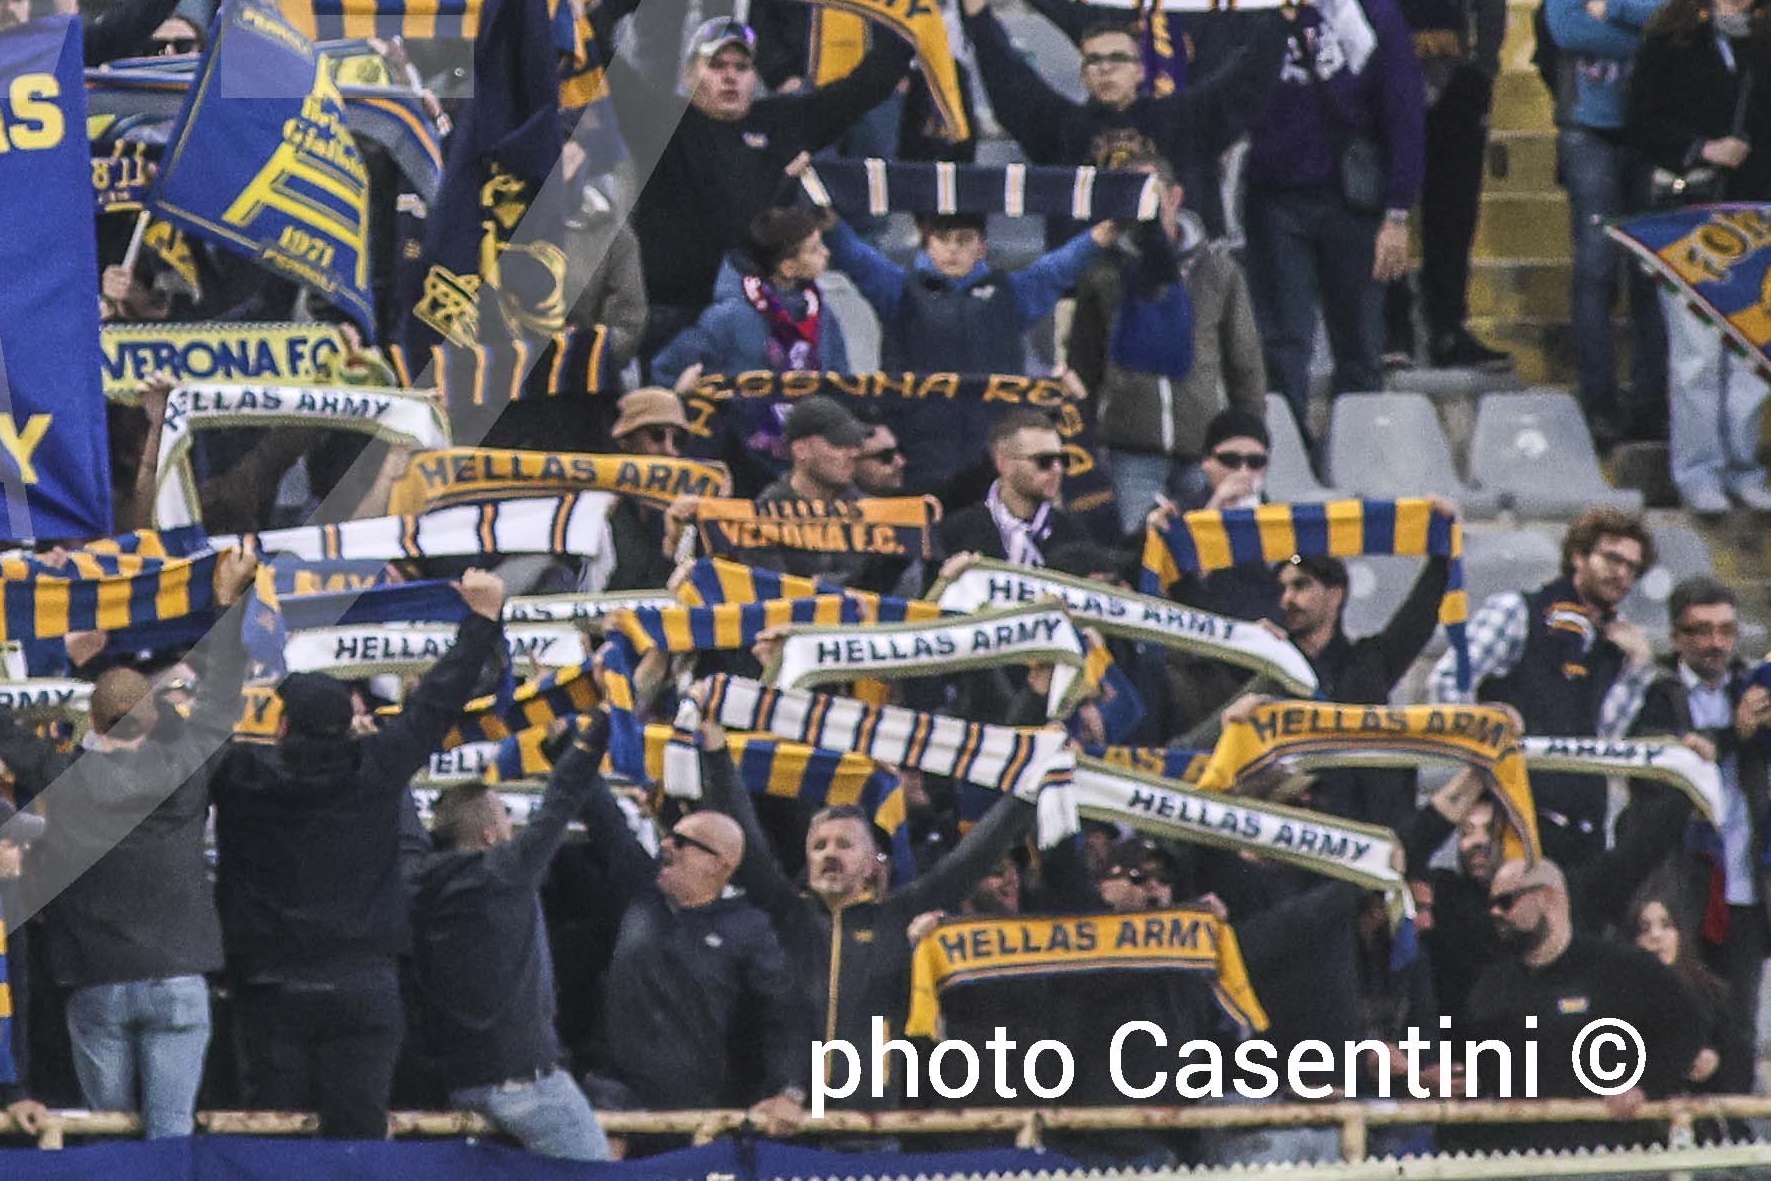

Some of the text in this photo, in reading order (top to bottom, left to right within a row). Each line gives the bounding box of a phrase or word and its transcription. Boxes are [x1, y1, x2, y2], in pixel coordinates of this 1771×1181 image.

[101, 337, 281, 381] VERONA
[166, 389, 392, 431] HELLAS ARMY
[417, 453, 598, 487] HELLAS
[988, 577, 1127, 618] HELAS
[816, 617, 1063, 664] HELLAS ARMY
[1252, 708, 1410, 745] HELLAS
[1127, 787, 1372, 863] HELLAS ARMY
[939, 921, 1098, 963] HELLAS
